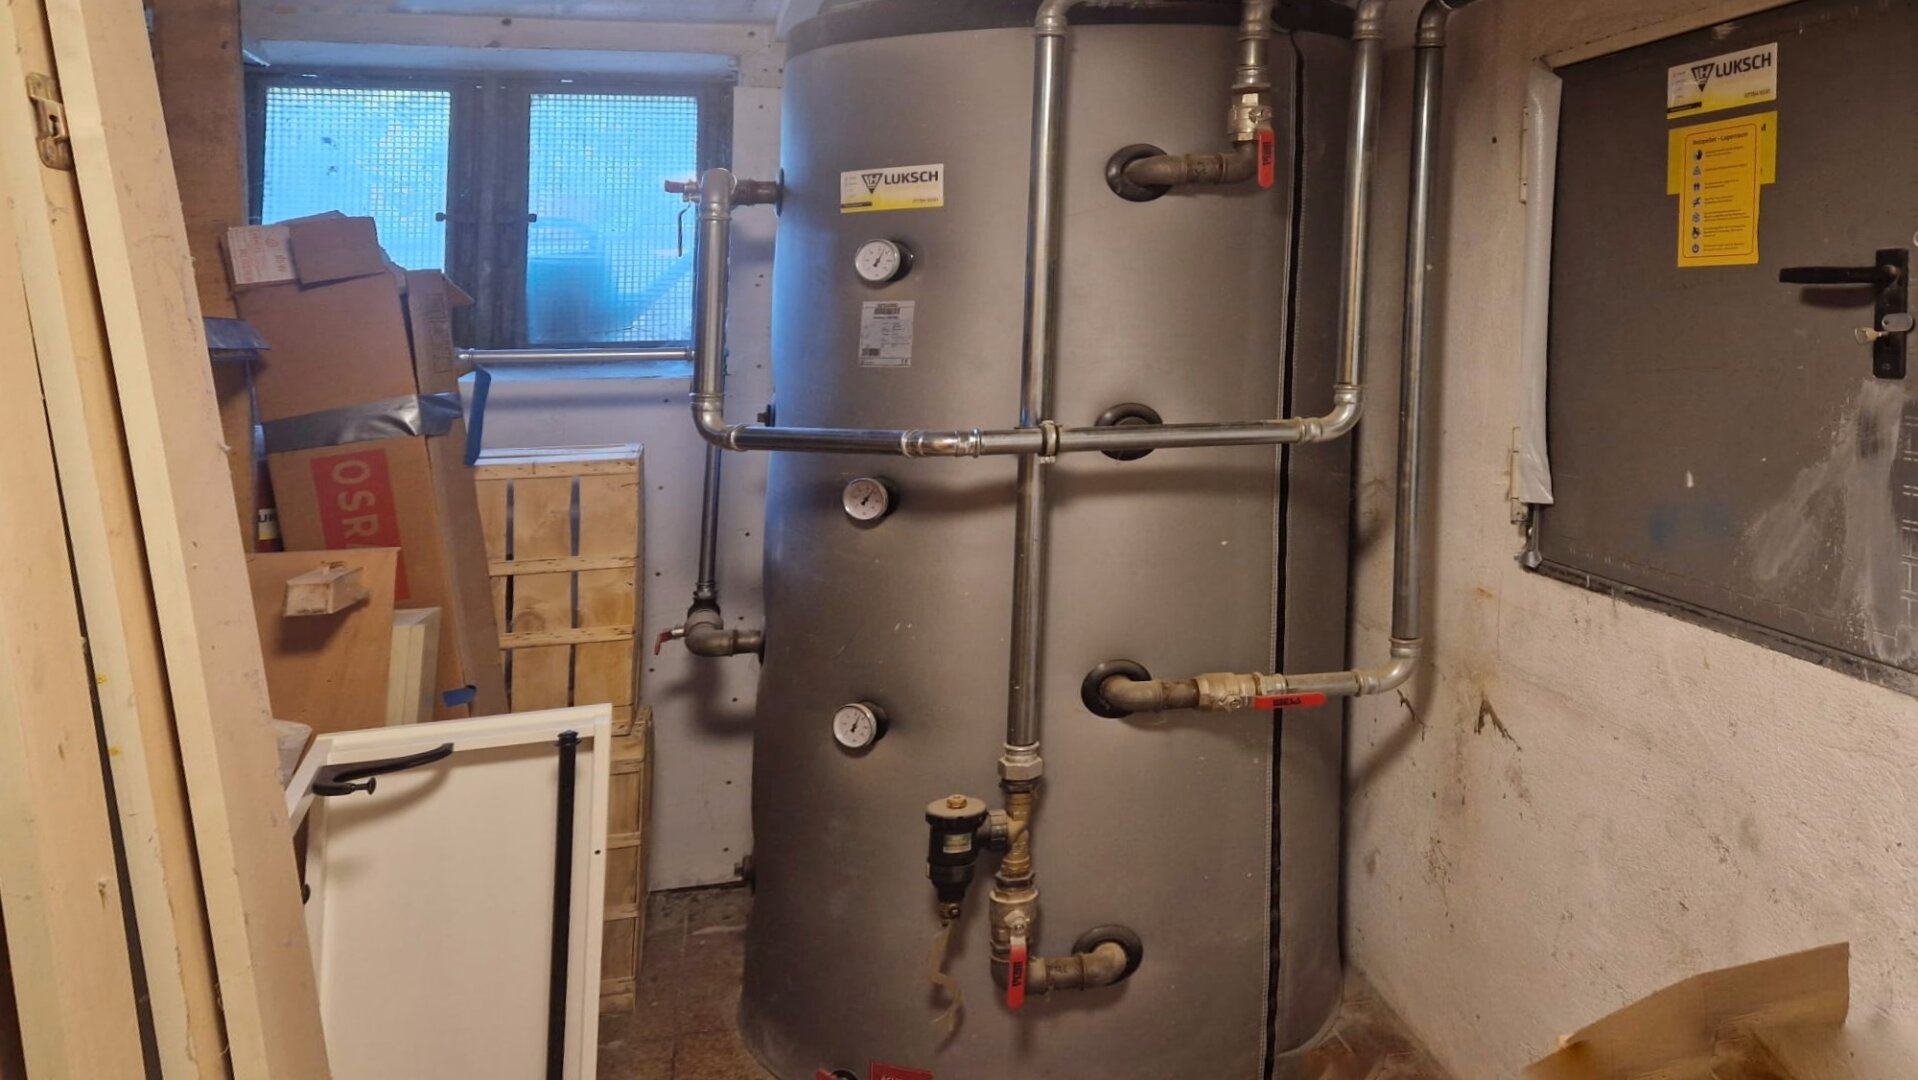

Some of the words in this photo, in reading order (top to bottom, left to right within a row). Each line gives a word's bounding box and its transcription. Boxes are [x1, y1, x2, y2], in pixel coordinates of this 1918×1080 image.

[1715, 52, 1772, 78] LUKSCH
[884, 170, 939, 185] LUKSCH
[332, 459, 382, 549] OSR
